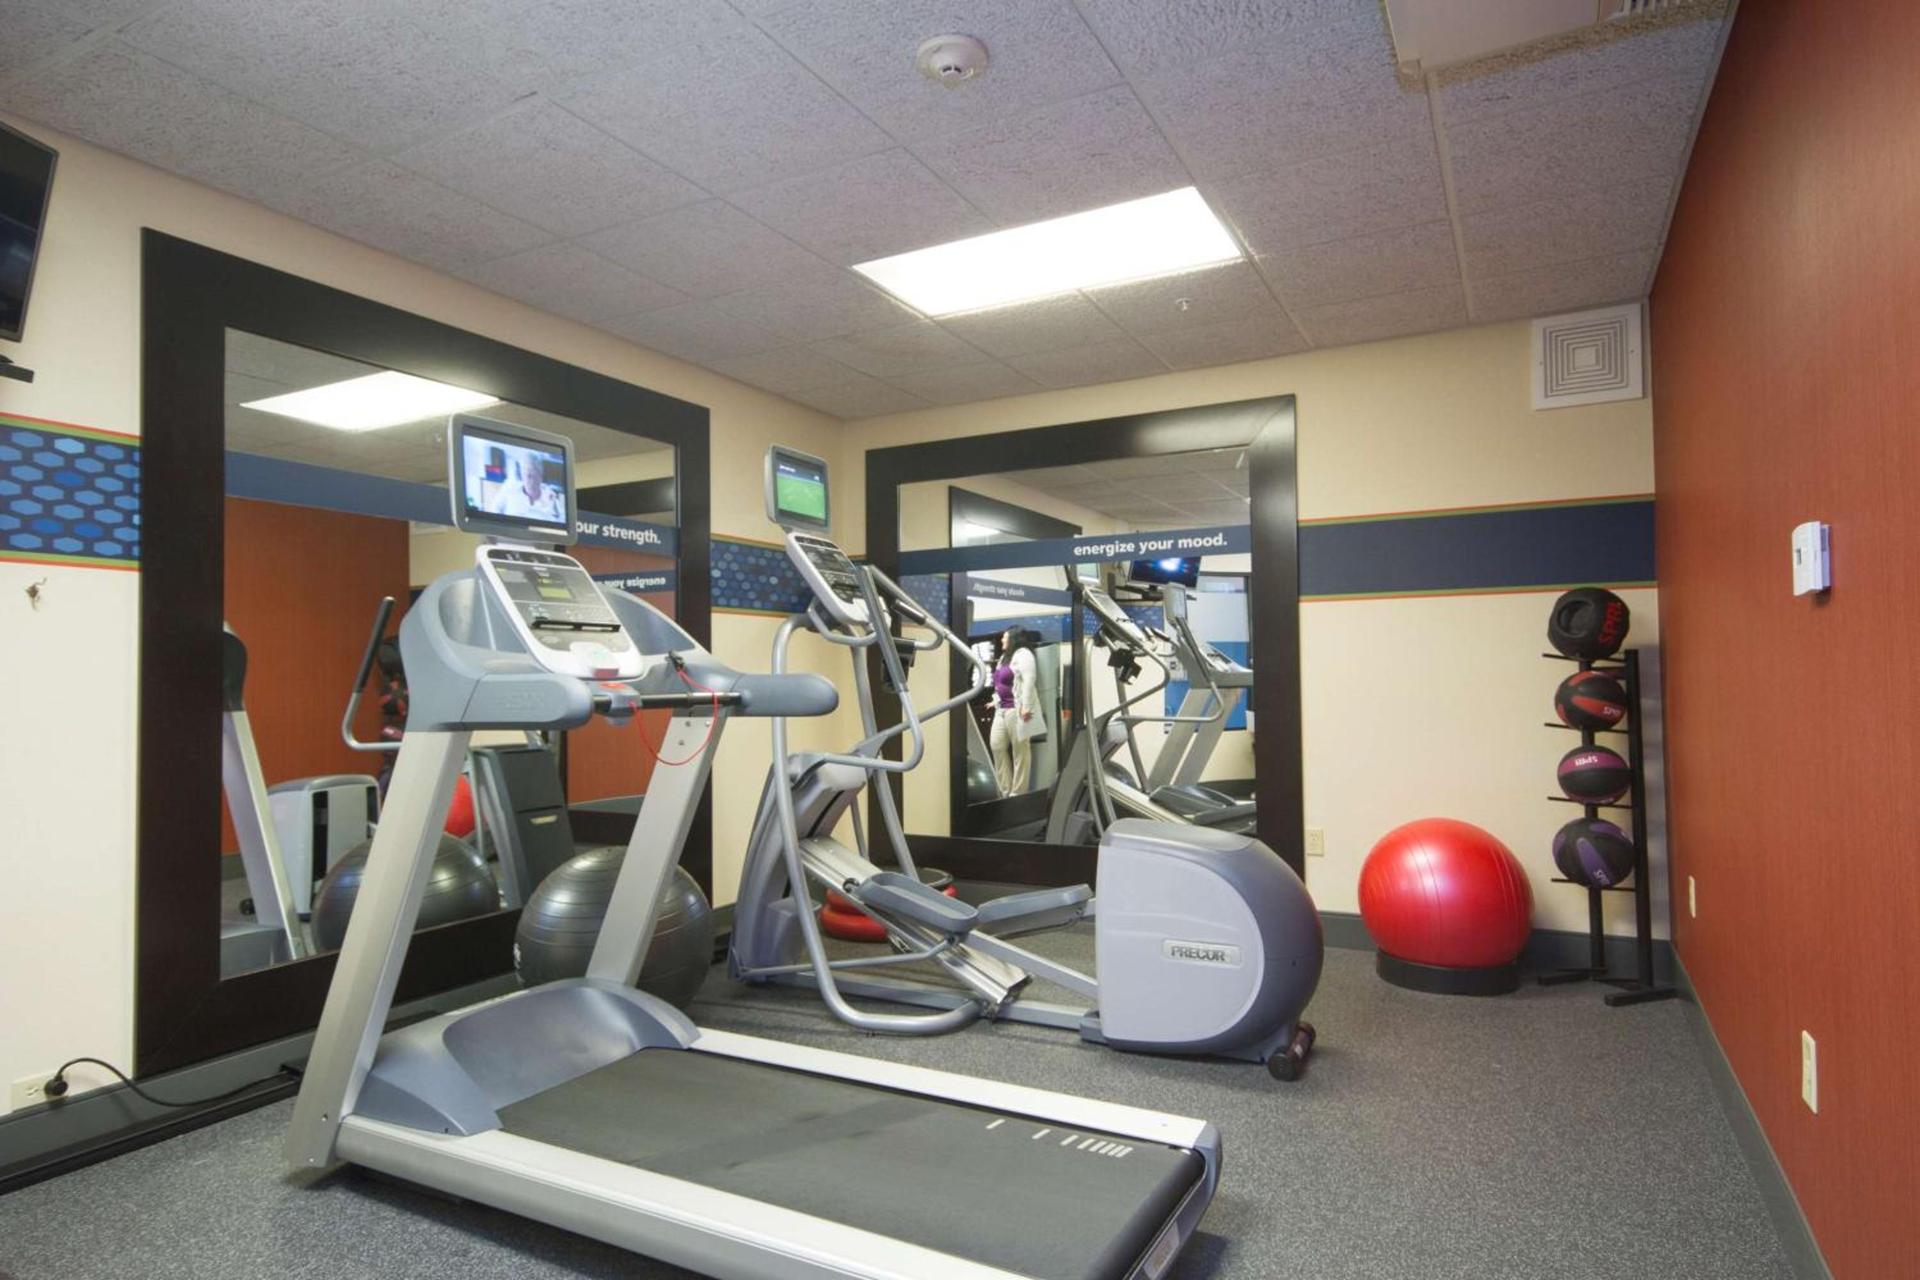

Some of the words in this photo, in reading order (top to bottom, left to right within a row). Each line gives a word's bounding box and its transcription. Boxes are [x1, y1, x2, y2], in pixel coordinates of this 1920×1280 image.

[575, 521, 600, 535] our
[602, 524, 662, 545] strength.
[1073, 540, 1135, 557] energize
[1139, 538, 1174, 555] your
[1177, 532, 1228, 549] mood.
[1171, 945, 1226, 961] PRECOR
